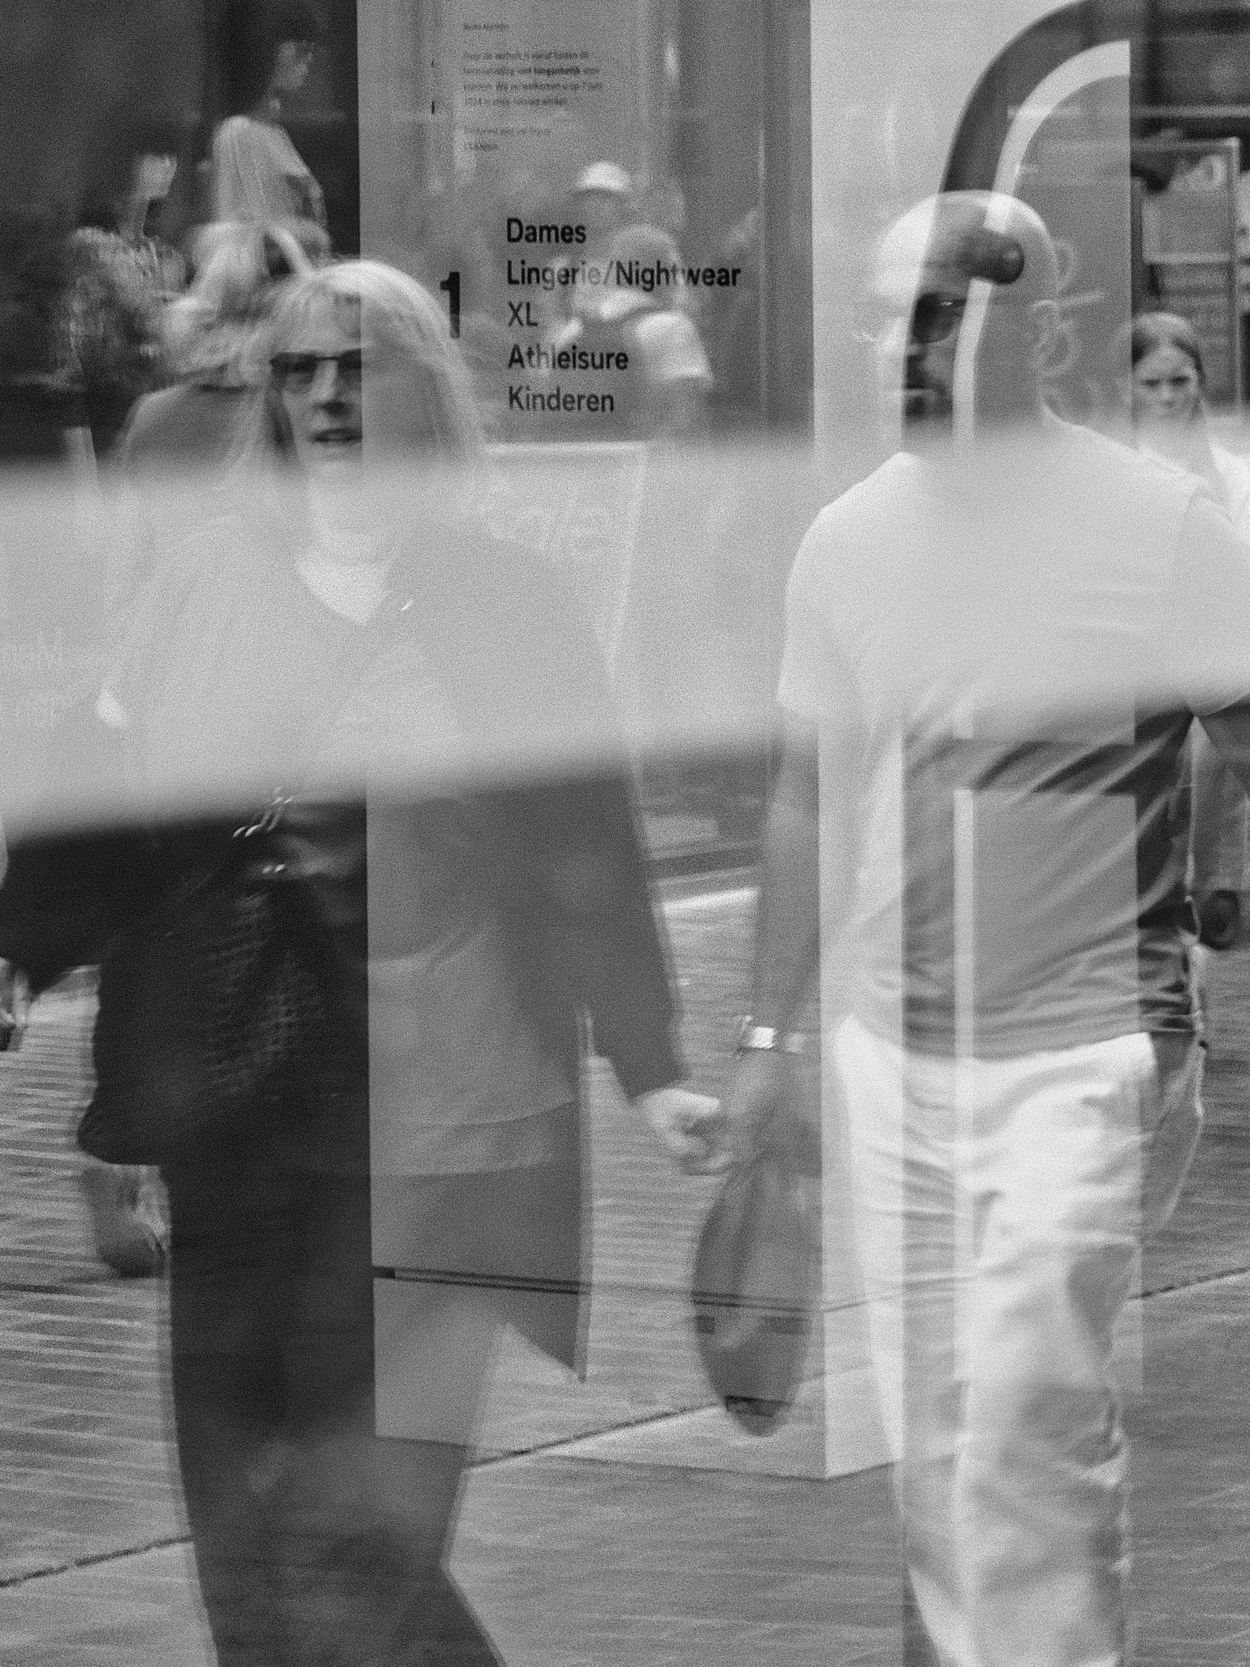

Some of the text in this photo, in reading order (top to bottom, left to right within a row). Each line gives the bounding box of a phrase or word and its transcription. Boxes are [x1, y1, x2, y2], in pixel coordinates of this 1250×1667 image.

[507, 217, 586, 243] Dames
[507, 260, 741, 292] Lingerie/Nightwear
[440, 271, 461, 338] 1
[508, 301, 538, 327] XL
[508, 344, 629, 370] Athleisure
[508, 385, 614, 412] Kinderen
